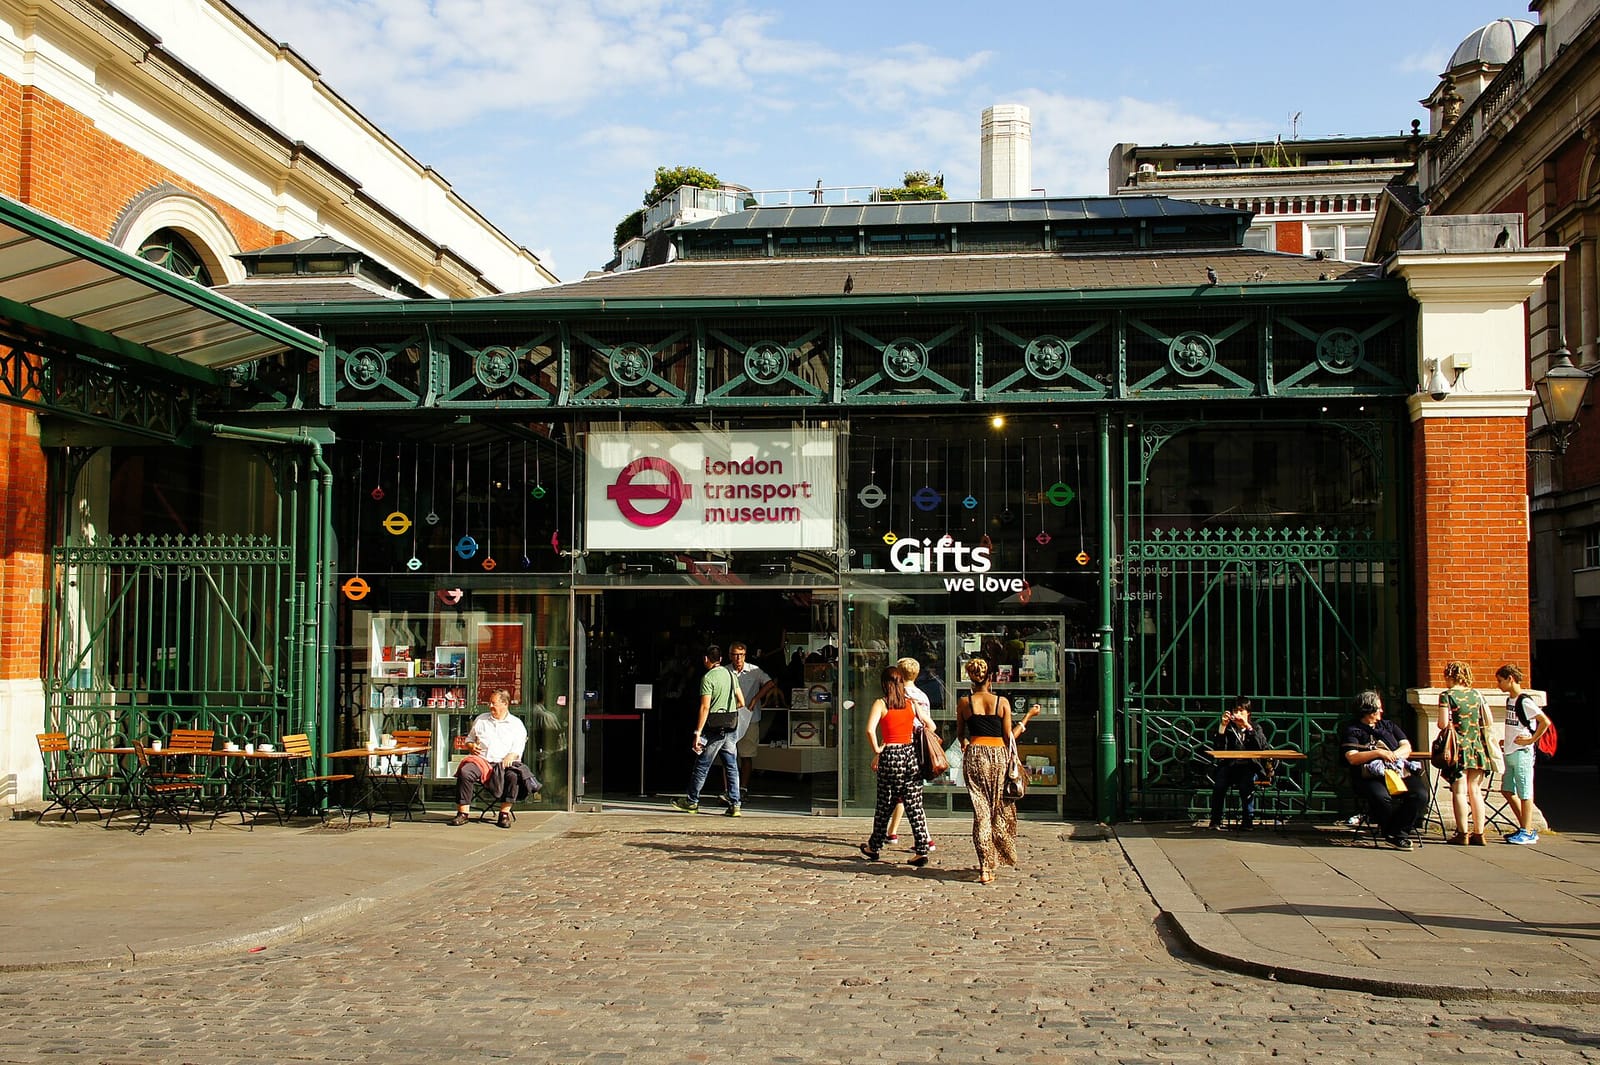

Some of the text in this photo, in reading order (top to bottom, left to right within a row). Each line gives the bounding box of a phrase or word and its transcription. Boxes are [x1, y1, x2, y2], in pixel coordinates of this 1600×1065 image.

[705, 456, 783, 475] london
[703, 481, 811, 503] transport
[705, 507, 801, 522] museum
[890, 537, 992, 573] Gifts
[944, 574, 1023, 592] we love
